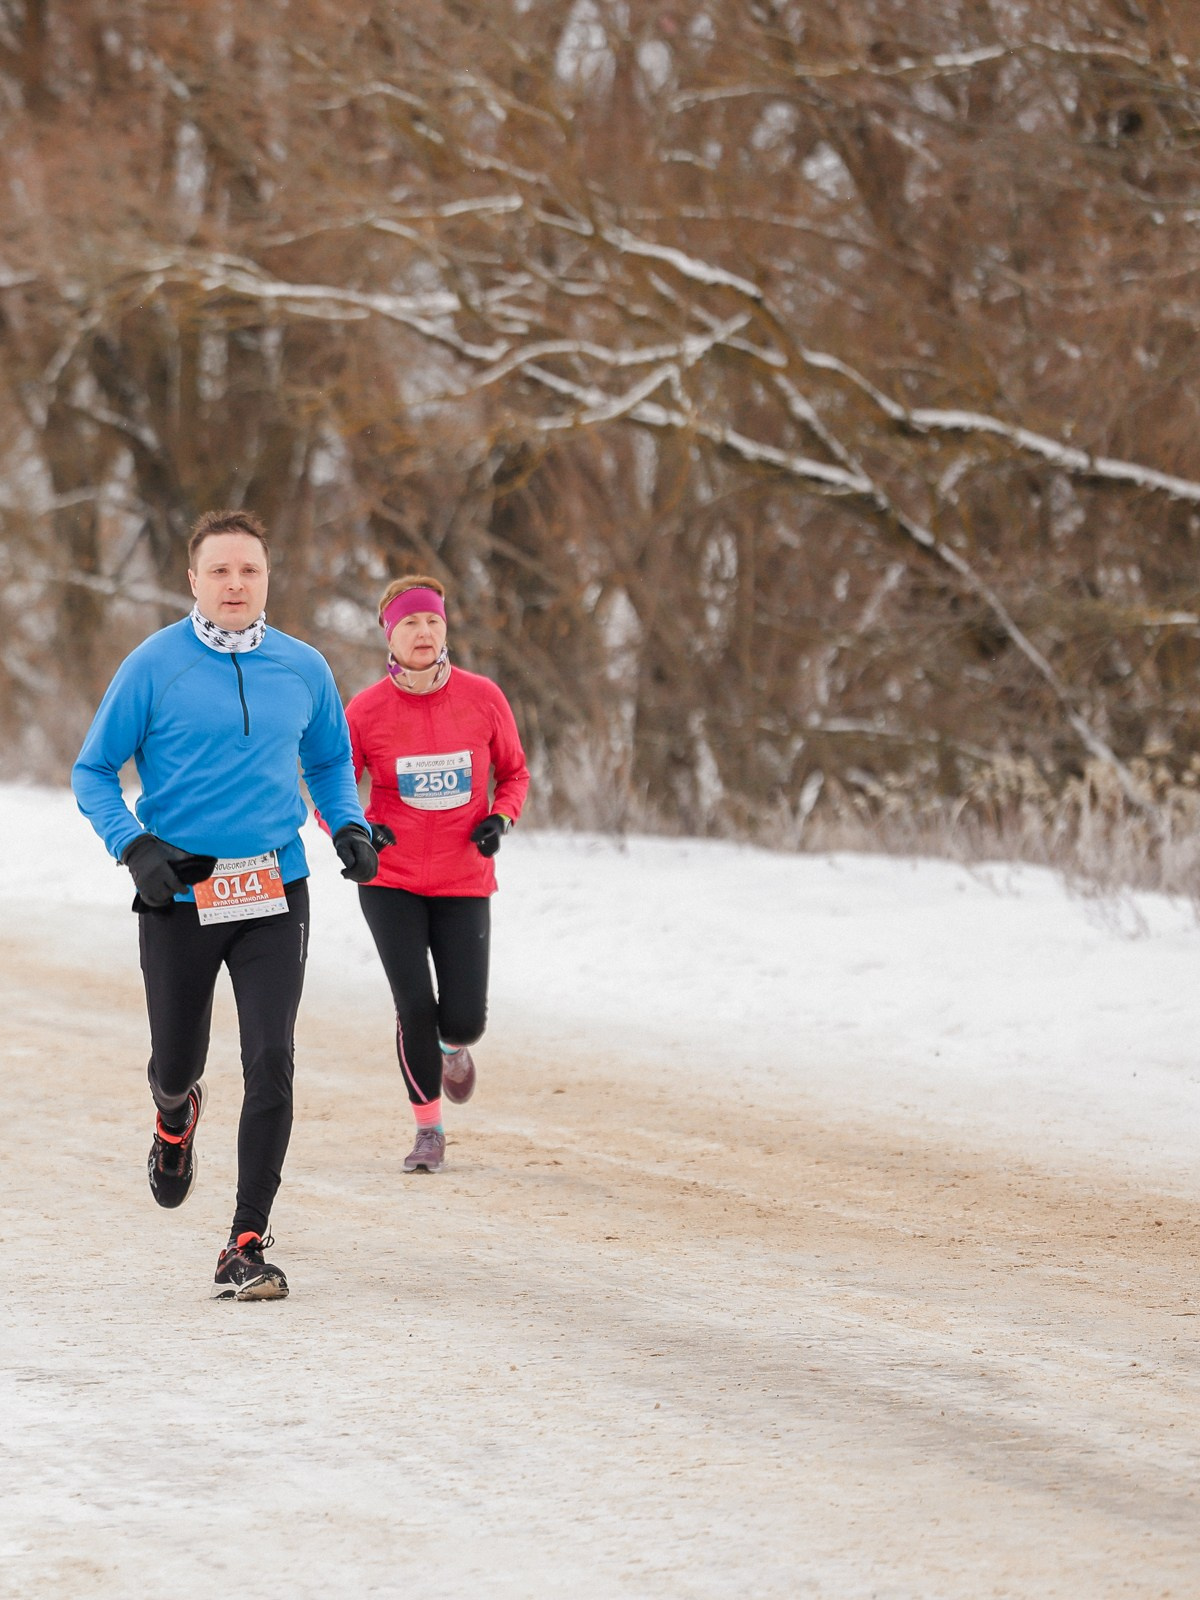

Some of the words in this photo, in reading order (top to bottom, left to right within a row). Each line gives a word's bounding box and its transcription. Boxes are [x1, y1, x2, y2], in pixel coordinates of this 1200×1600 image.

[415, 771, 458, 793] 250
[213, 872, 263, 899] 014
[212, 899, 239, 907] БУЛАТОВ
[240, 894, 269, 904] НИКОЛАЙ
